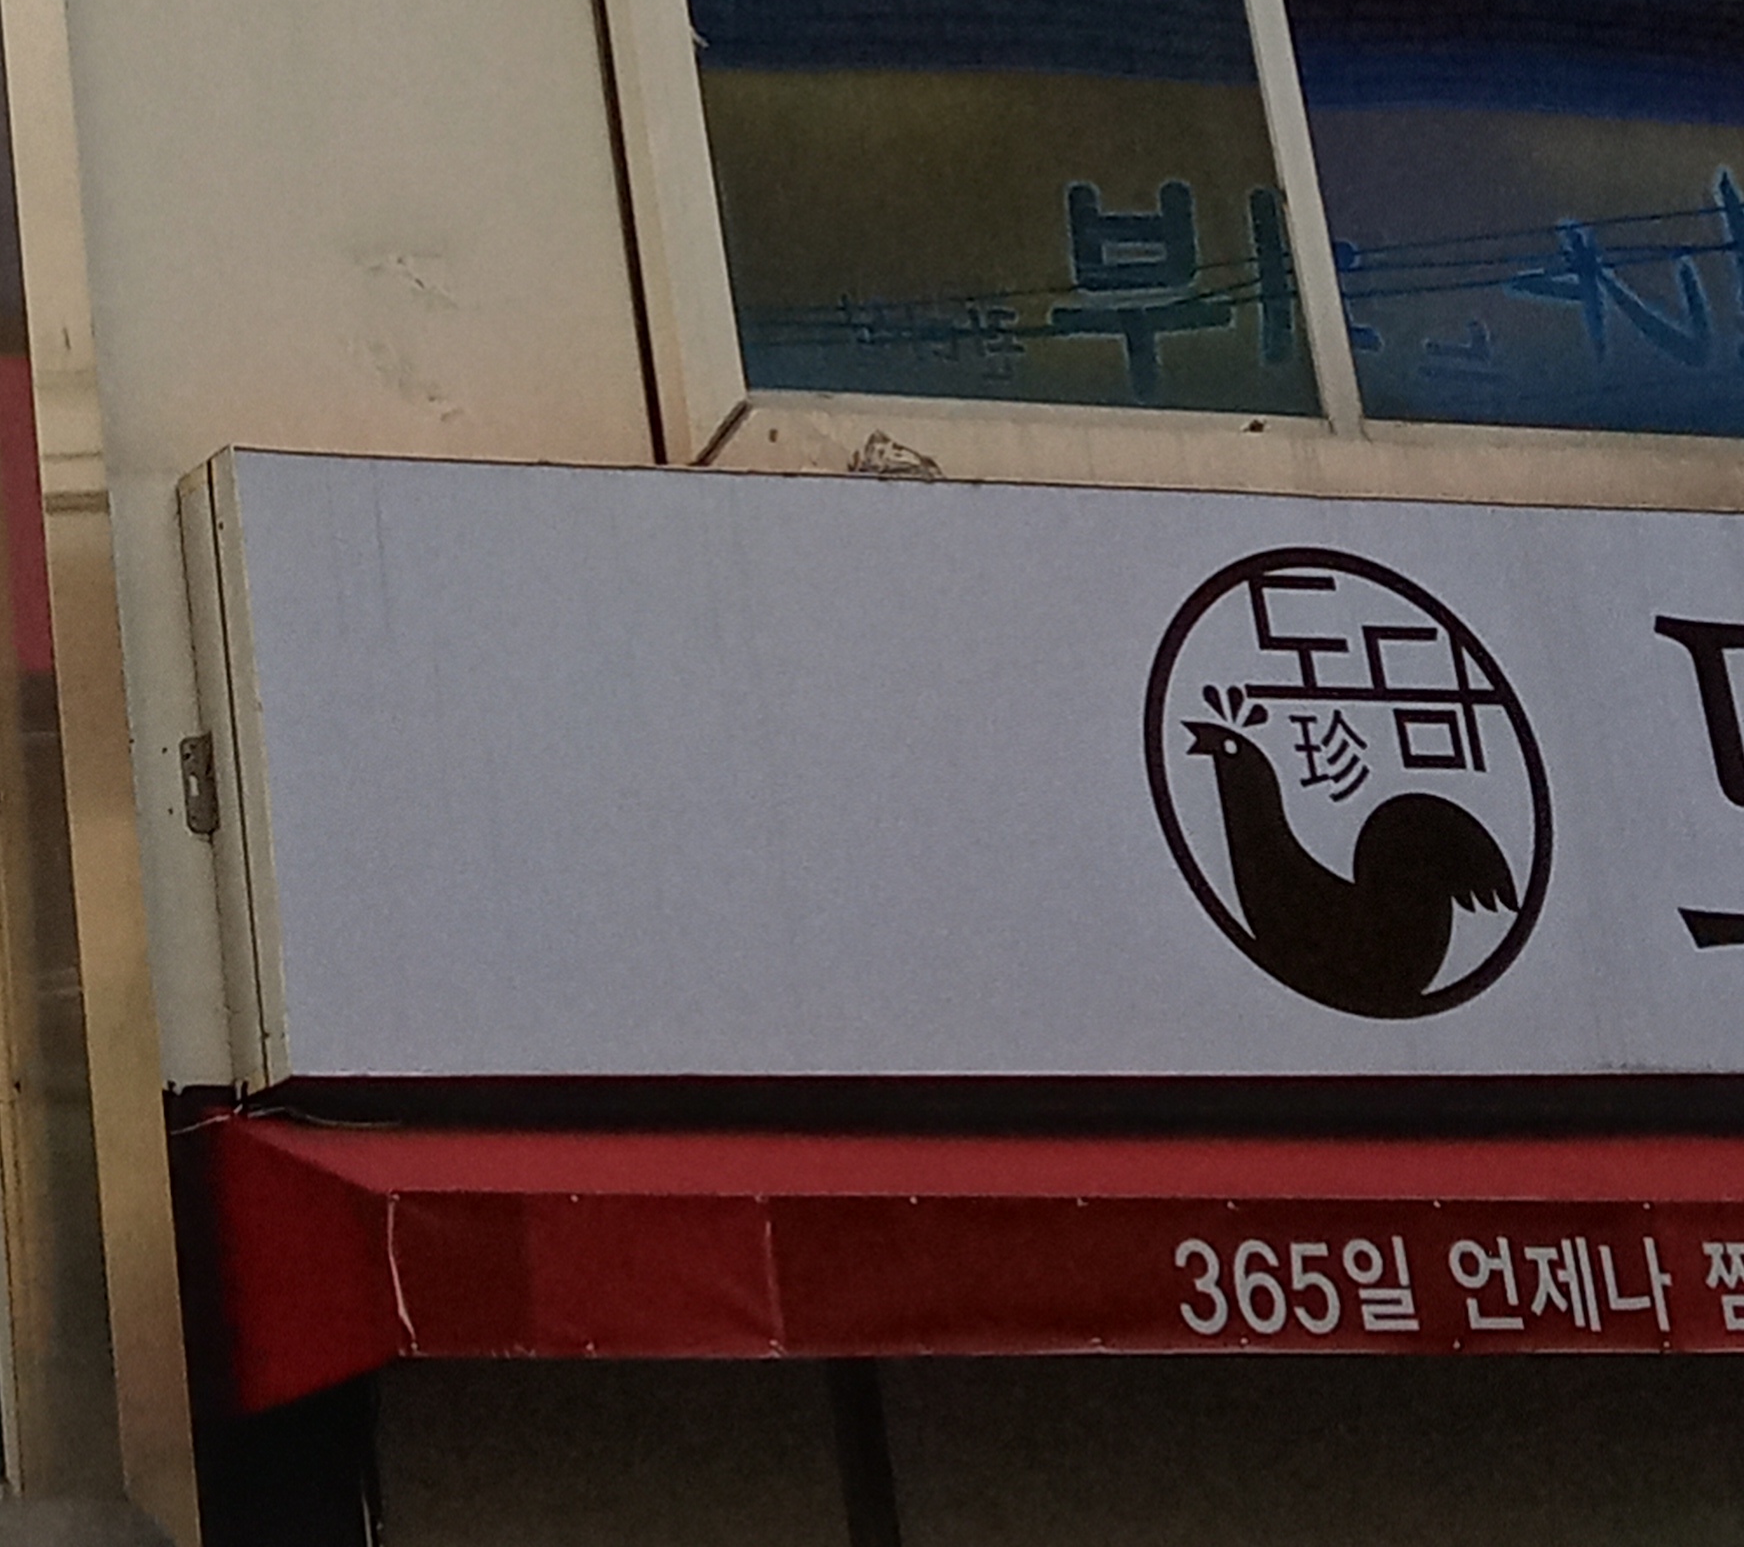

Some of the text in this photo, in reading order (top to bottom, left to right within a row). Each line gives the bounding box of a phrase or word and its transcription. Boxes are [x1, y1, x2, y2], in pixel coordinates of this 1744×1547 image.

[1289, 709, 1369, 803] 珍
[1174, 1235, 1421, 1335] 365일
[1447, 1236, 1673, 1333] 언제나
